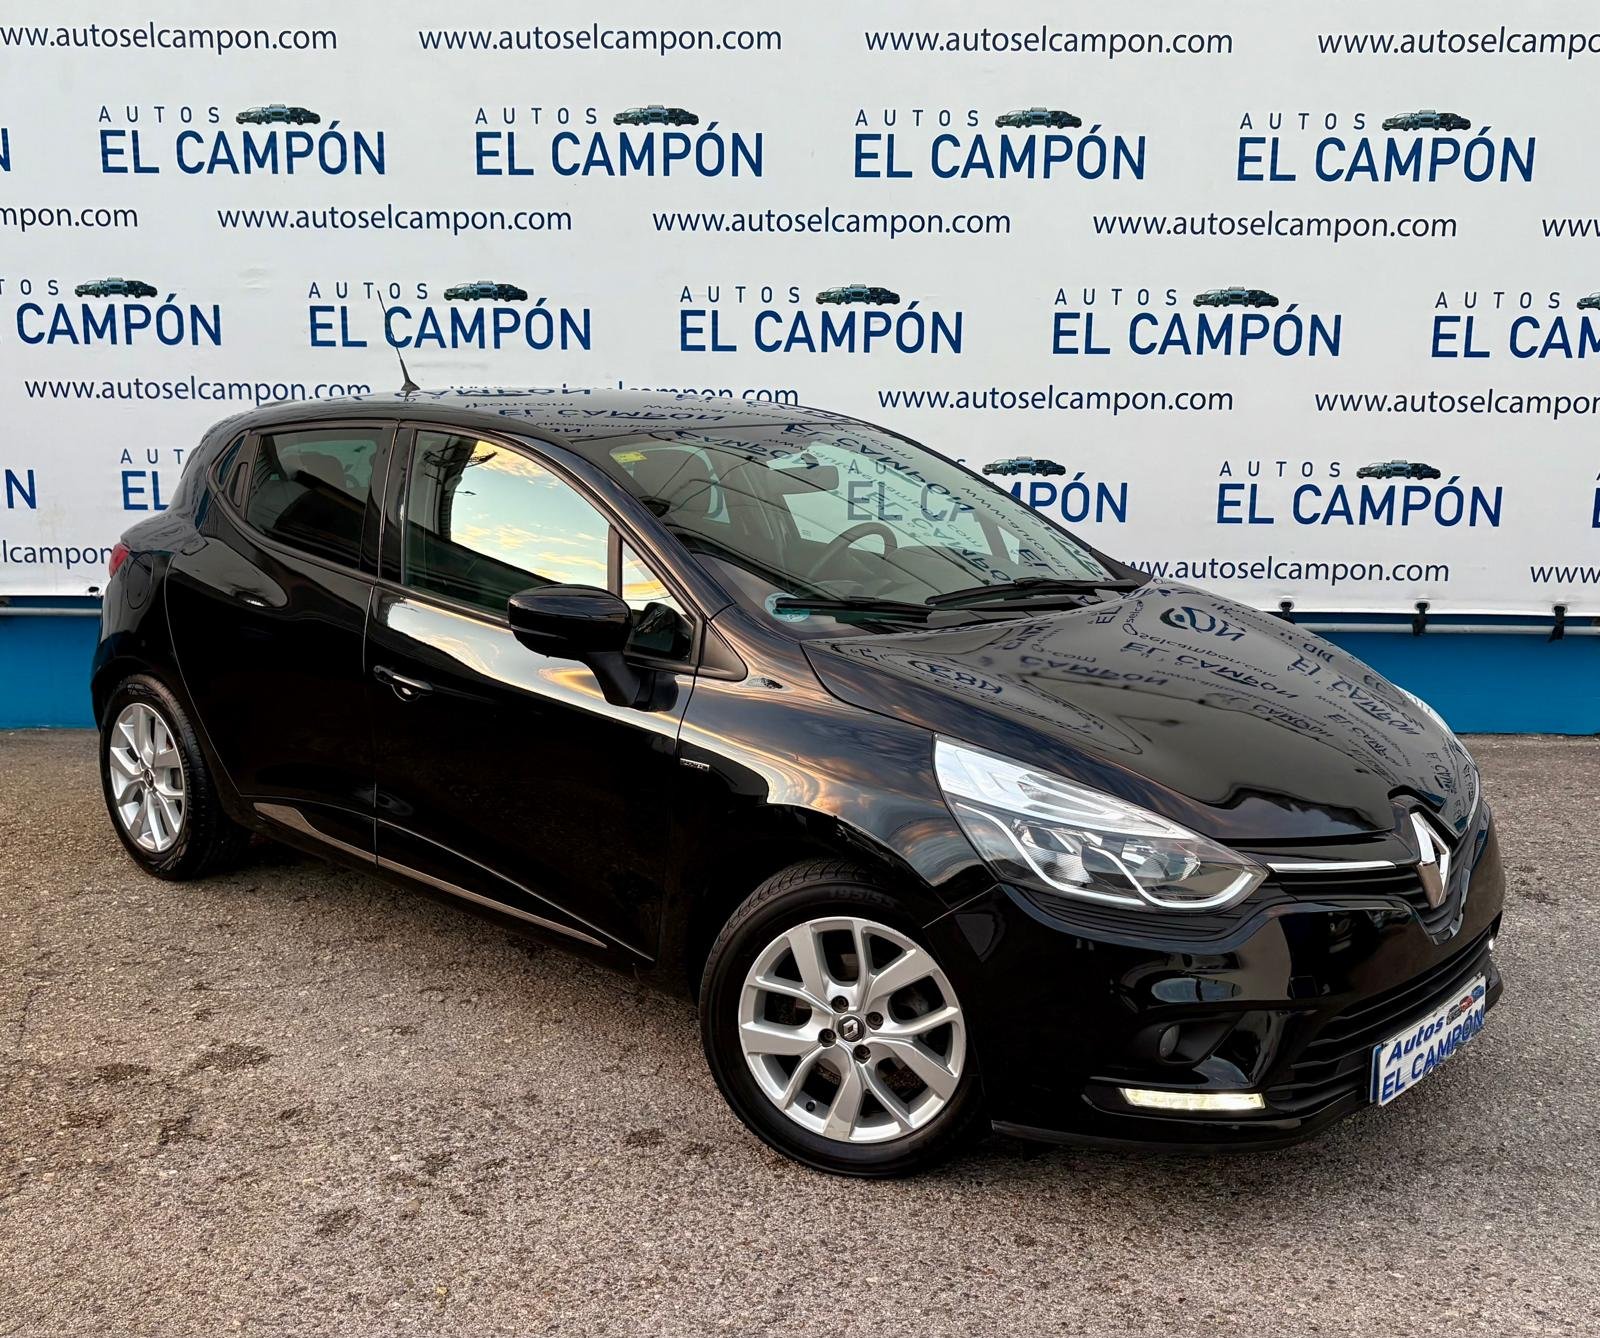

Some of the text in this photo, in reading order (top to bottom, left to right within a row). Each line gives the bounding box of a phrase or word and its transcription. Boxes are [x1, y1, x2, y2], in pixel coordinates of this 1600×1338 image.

[419, 23, 781, 56] www.autoselcampon.com
[865, 25, 1232, 59] www.autoselcampon.com
[99, 106, 219, 123] AUTOS
[475, 108, 596, 124] AUTOS
[855, 109, 978, 127] AUTOS
[1240, 113, 1365, 130] AUTOS
[100, 121, 385, 175] EL CAMPÓN
[476, 122, 762, 177] EL CAMPÓN
[855, 125, 1145, 179] EL CAMPÓN
[1237, 127, 1535, 182] EL CAMPÓN
[217, 204, 571, 236] www.autoselcampon.com
[653, 207, 1010, 239] www.autoselcampon.com
[1093, 210, 1456, 243] www.autoselcampon.com
[309, 282, 427, 299] AUTOS
[680, 286, 799, 303] AUTOS
[1055, 288, 1176, 306] AUTOS
[1435, 292, 1560, 309] AUTOS
[17, 294, 221, 346] CAMPÓN
[310, 298, 590, 350] EL CAMPÓN
[681, 301, 962, 353] EL CAMPÓN
[1053, 304, 1341, 356] EL CAMPÓN
[1432, 316, 1490, 358] EL
[878, 385, 1232, 415] www.autoselcampon.com
[1219, 461, 1340, 477] AUTOS
[1217, 476, 1502, 527] EL CAMPÓN
[1122, 556, 1448, 587] w.autoselcampon.com
[1382, 1005, 1485, 1103] EL CAMPÓN
[1386, 1016, 1444, 1068] Autos
